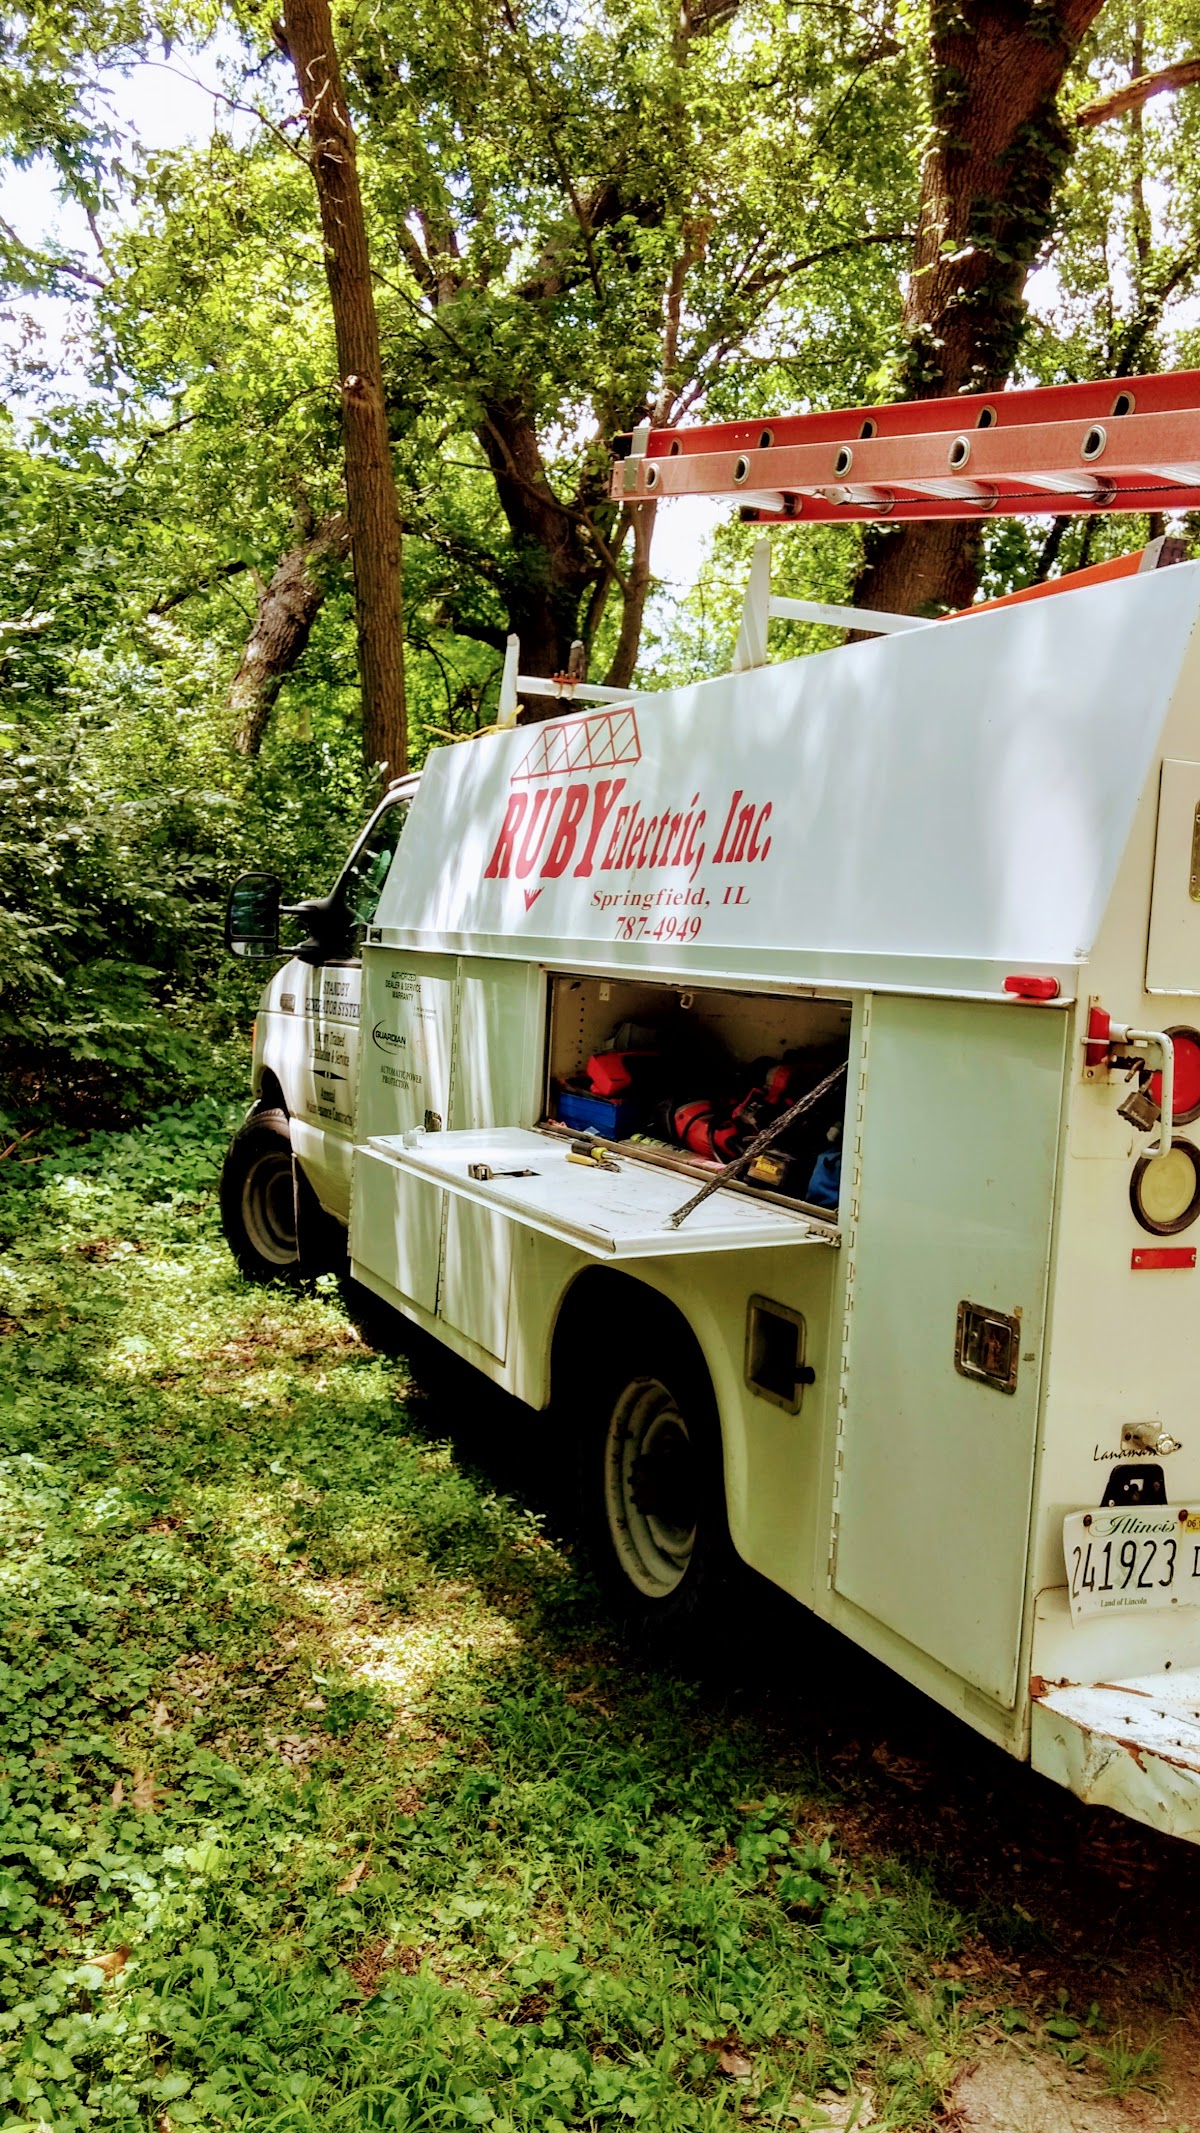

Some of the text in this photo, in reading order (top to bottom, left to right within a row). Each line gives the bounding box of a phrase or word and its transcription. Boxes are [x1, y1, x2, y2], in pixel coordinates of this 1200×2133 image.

[484, 777, 773, 883] RUBY Electric, Inc.
[590, 886, 751, 911] Springfield, IL
[614, 915, 702, 942] 787-4949
[323, 981, 350, 997] STANDBY
[385, 979, 400, 990] DEALER
[404, 982, 422, 993] SERVICE
[392, 990, 414, 1002] WARRANTY
[375, 1030, 407, 1045] GUARDIAN
[380, 1064, 423, 1085] AUTOMATIC POWER
[382, 1074, 410, 1091] PROTECTION
[1087, 1514, 1178, 1538] Illinois
[1072, 1538, 1177, 1599] 241923
[1100, 1596, 1148, 1608] Land of Lincoln
